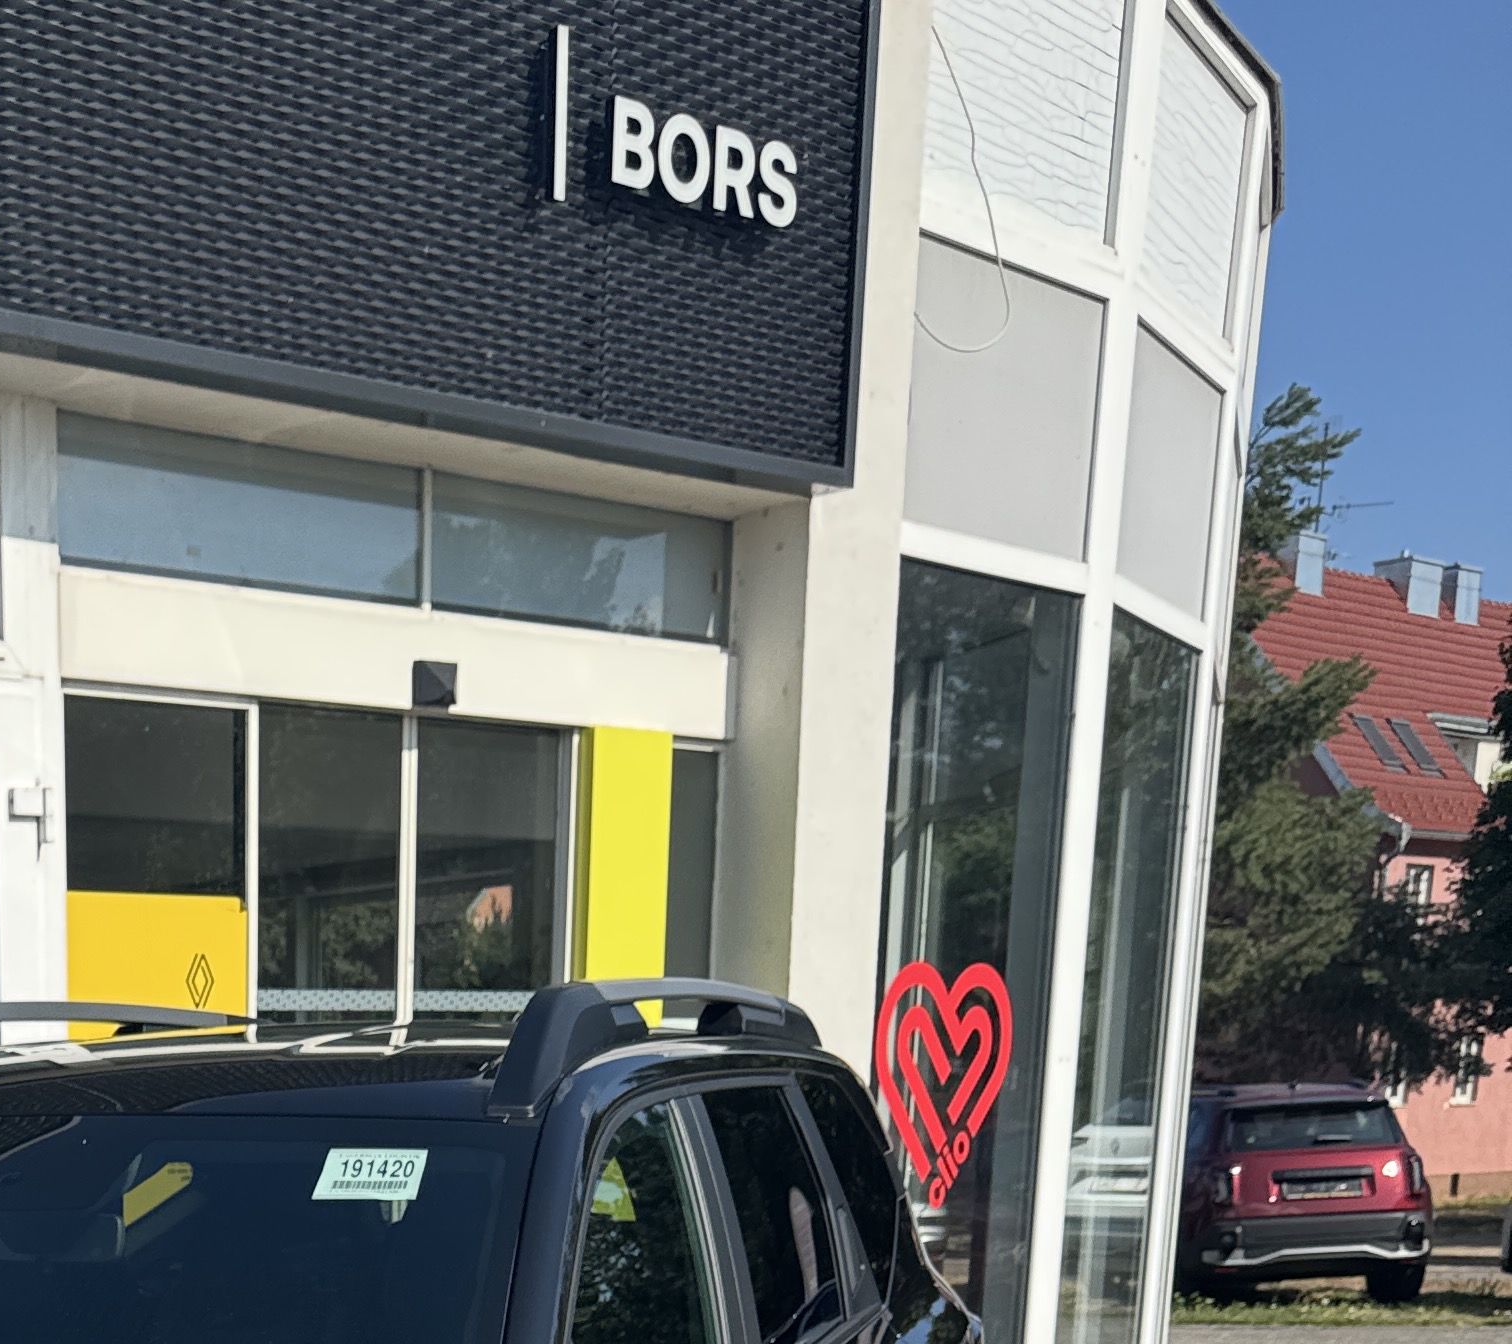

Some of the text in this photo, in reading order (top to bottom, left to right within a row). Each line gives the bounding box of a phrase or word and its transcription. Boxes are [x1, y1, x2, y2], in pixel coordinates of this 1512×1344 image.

[611, 95, 798, 228] BORS
[341, 1159, 415, 1178] 191420
[929, 1131, 970, 1210] clio
